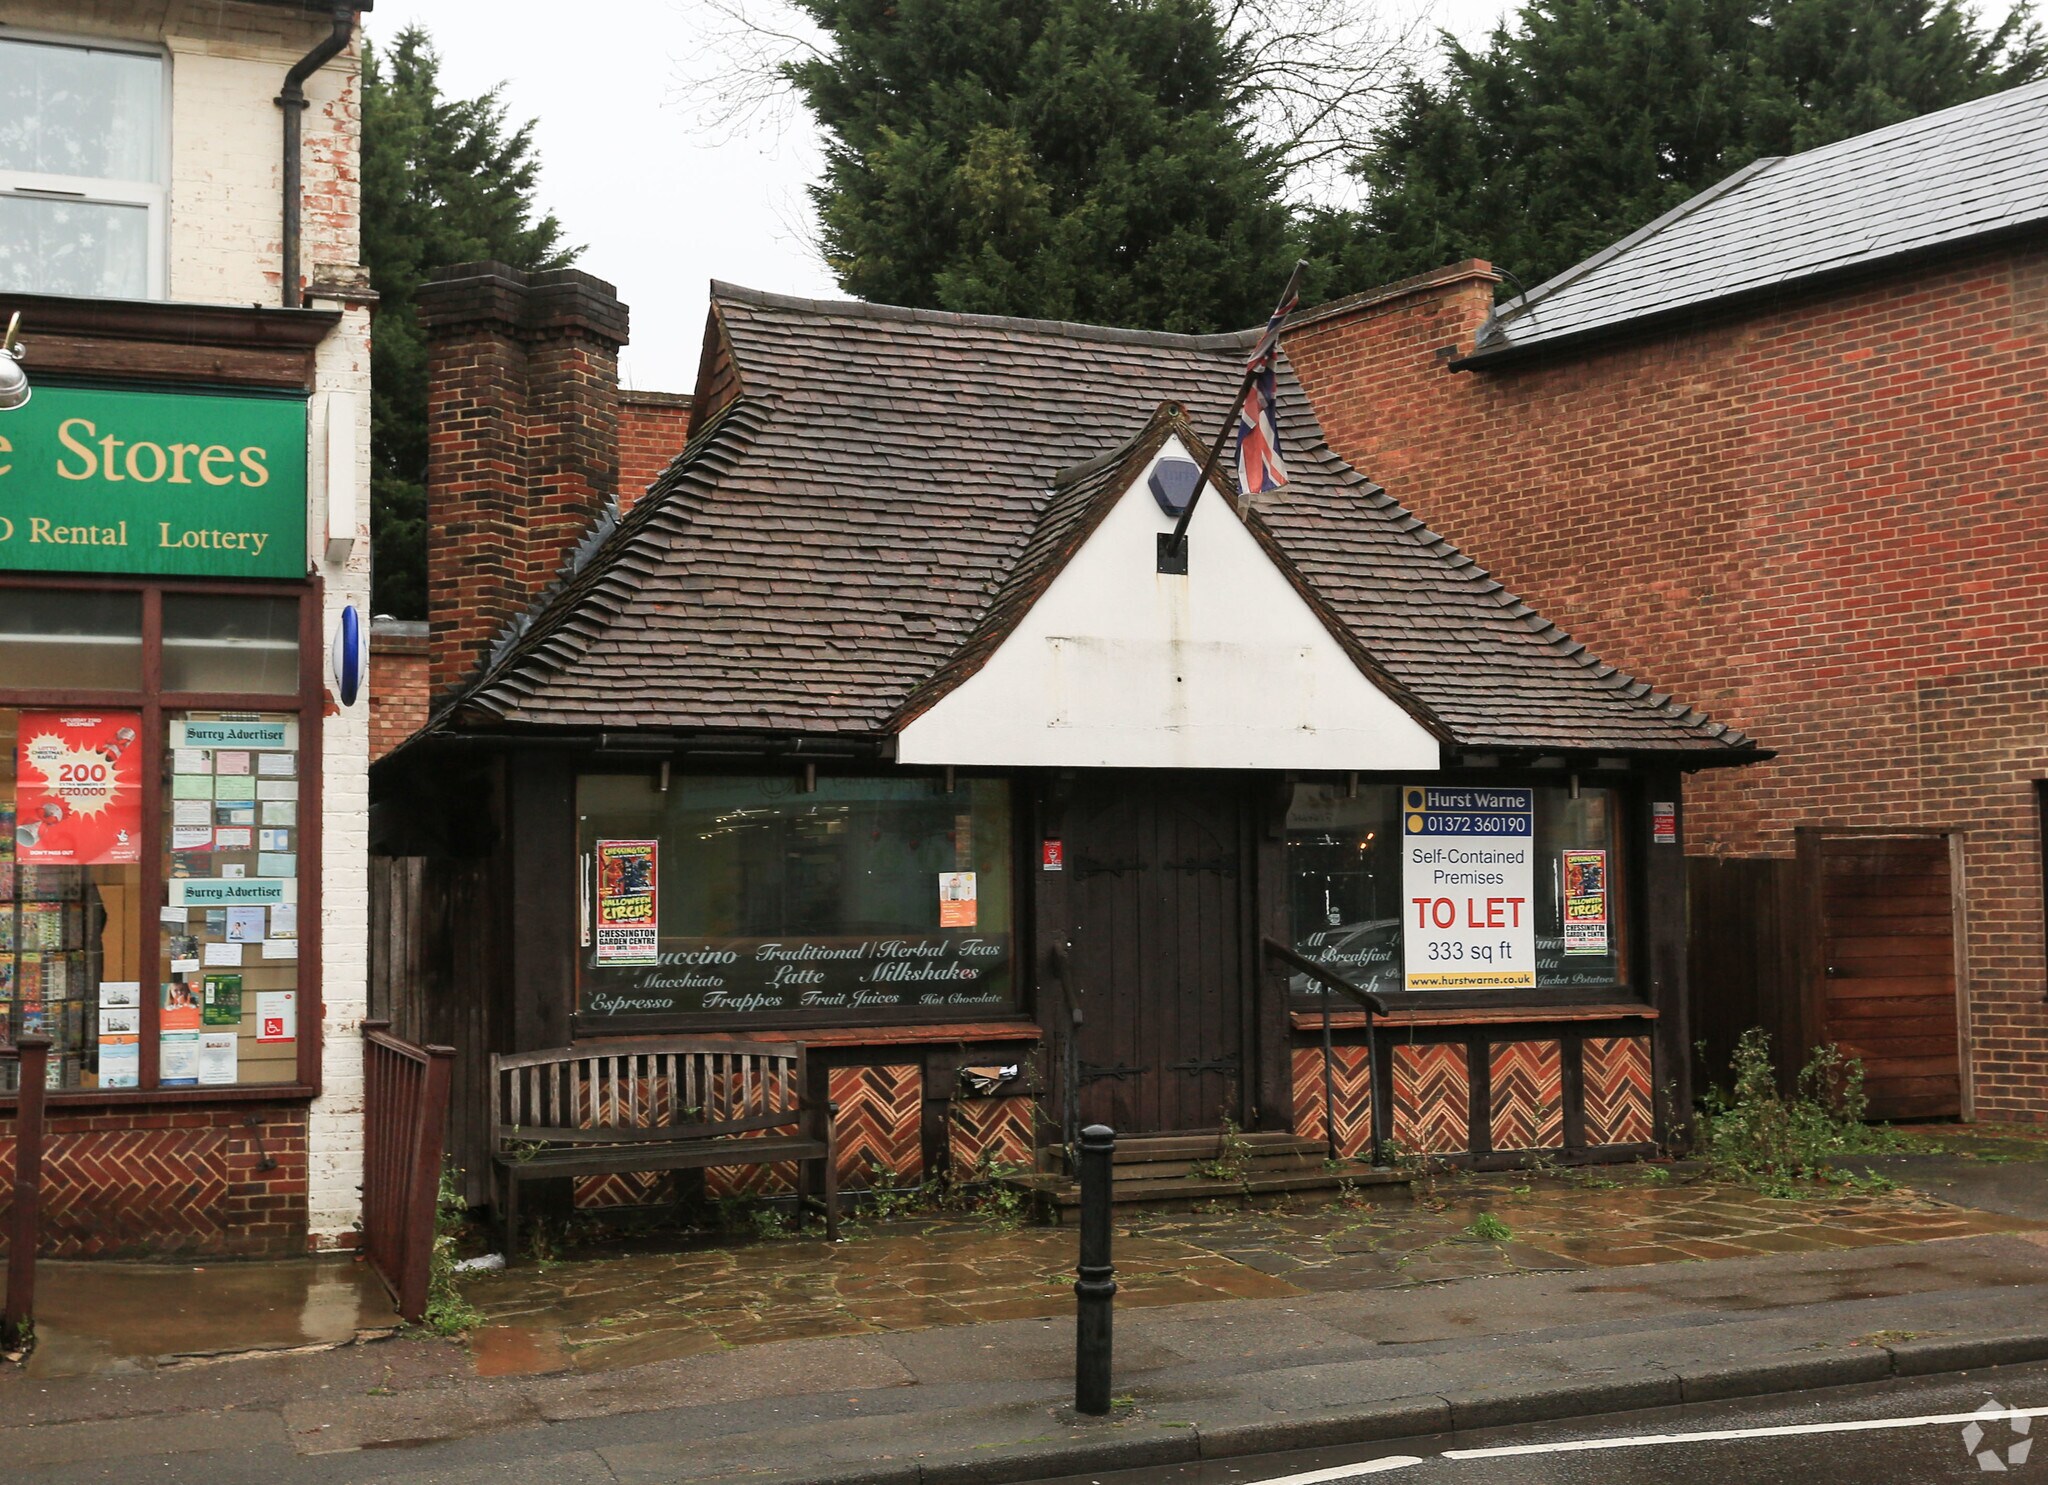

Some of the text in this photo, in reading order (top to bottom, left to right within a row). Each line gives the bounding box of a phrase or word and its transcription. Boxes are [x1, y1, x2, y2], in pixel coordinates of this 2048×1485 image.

[56, 418, 270, 487] Stores
[29, 517, 128, 546] Rental
[158, 522, 269, 556] Lottery
[187, 728, 284, 741] Surrey Advertiser
[59, 764, 107, 782] 200
[59, 787, 107, 797] £20,000
[1428, 792, 1526, 808] Hurst Warne
[1428, 817, 1526, 832] 01372 360190
[1412, 848, 1525, 864] Self-Contained
[1434, 870, 1504, 885] Premises
[185, 886, 282, 900] Surrey Advertiser
[601, 896, 652, 907] HALLOWEEN
[602, 904, 653, 920] CIRCUS
[1412, 897, 1526, 929] TO LET
[1568, 904, 1603, 917] CIRCUS
[599, 929, 656, 938] CHESSINGTON
[755, 942, 868, 961] Traditional
[876, 939, 949, 959] Herbal
[958, 938, 1001, 957] Teas
[1320, 948, 1393, 967] Breakfast
[1428, 941, 1512, 964] 333 sq ft
[765, 964, 825, 989] Latte
[859, 961, 980, 983] Milkshakes
[1411, 974, 1531, 986] www.hurstwarne.co.uk
[1537, 973, 1615, 987] Jacket Potatoes
[634, 972, 725, 989] Macchiato
[590, 992, 674, 1016] Espresso
[701, 991, 783, 1013] Frappes
[800, 989, 900, 1009] Fruit Juices
[918, 992, 1003, 1005] Hot Chocolate
